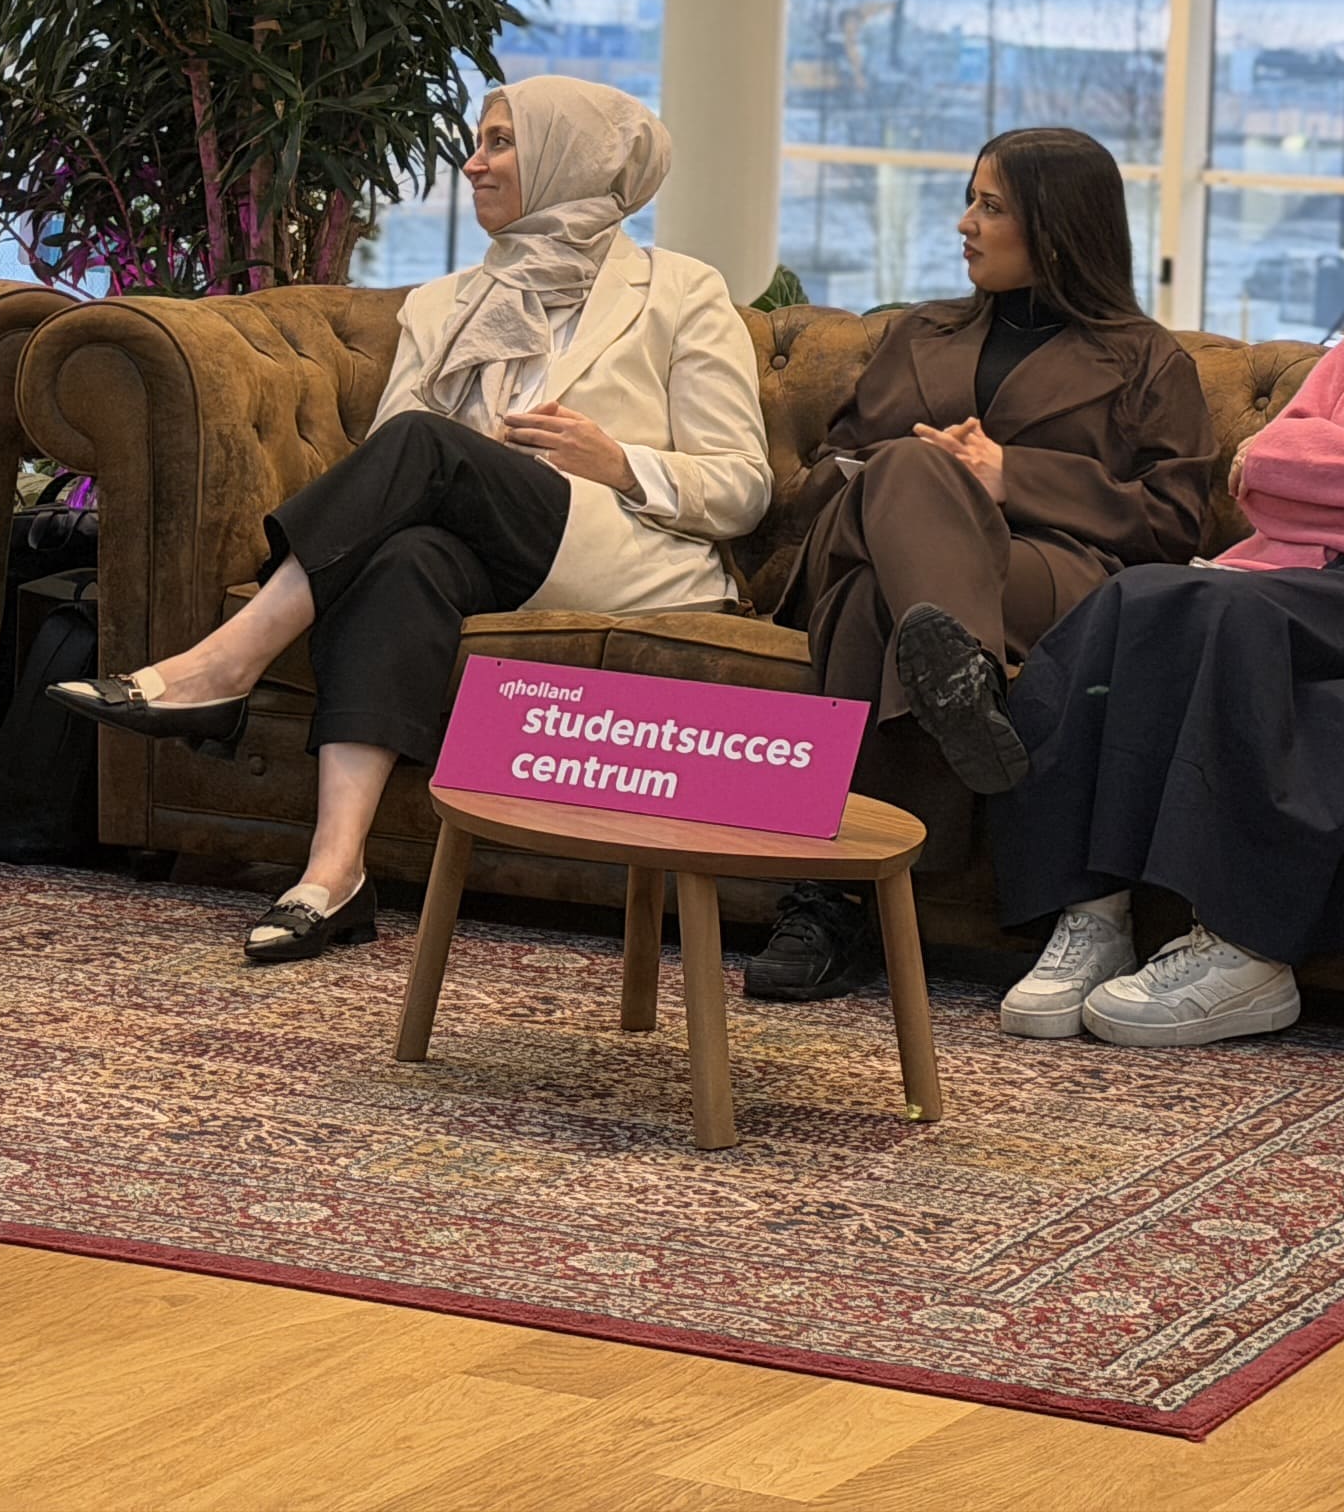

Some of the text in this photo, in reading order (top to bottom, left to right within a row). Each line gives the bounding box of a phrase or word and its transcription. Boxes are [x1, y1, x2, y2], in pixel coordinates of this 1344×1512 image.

[499, 679, 583, 703] inholland
[522, 704, 814, 769] studentsucces
[511, 752, 678, 799] centrum
